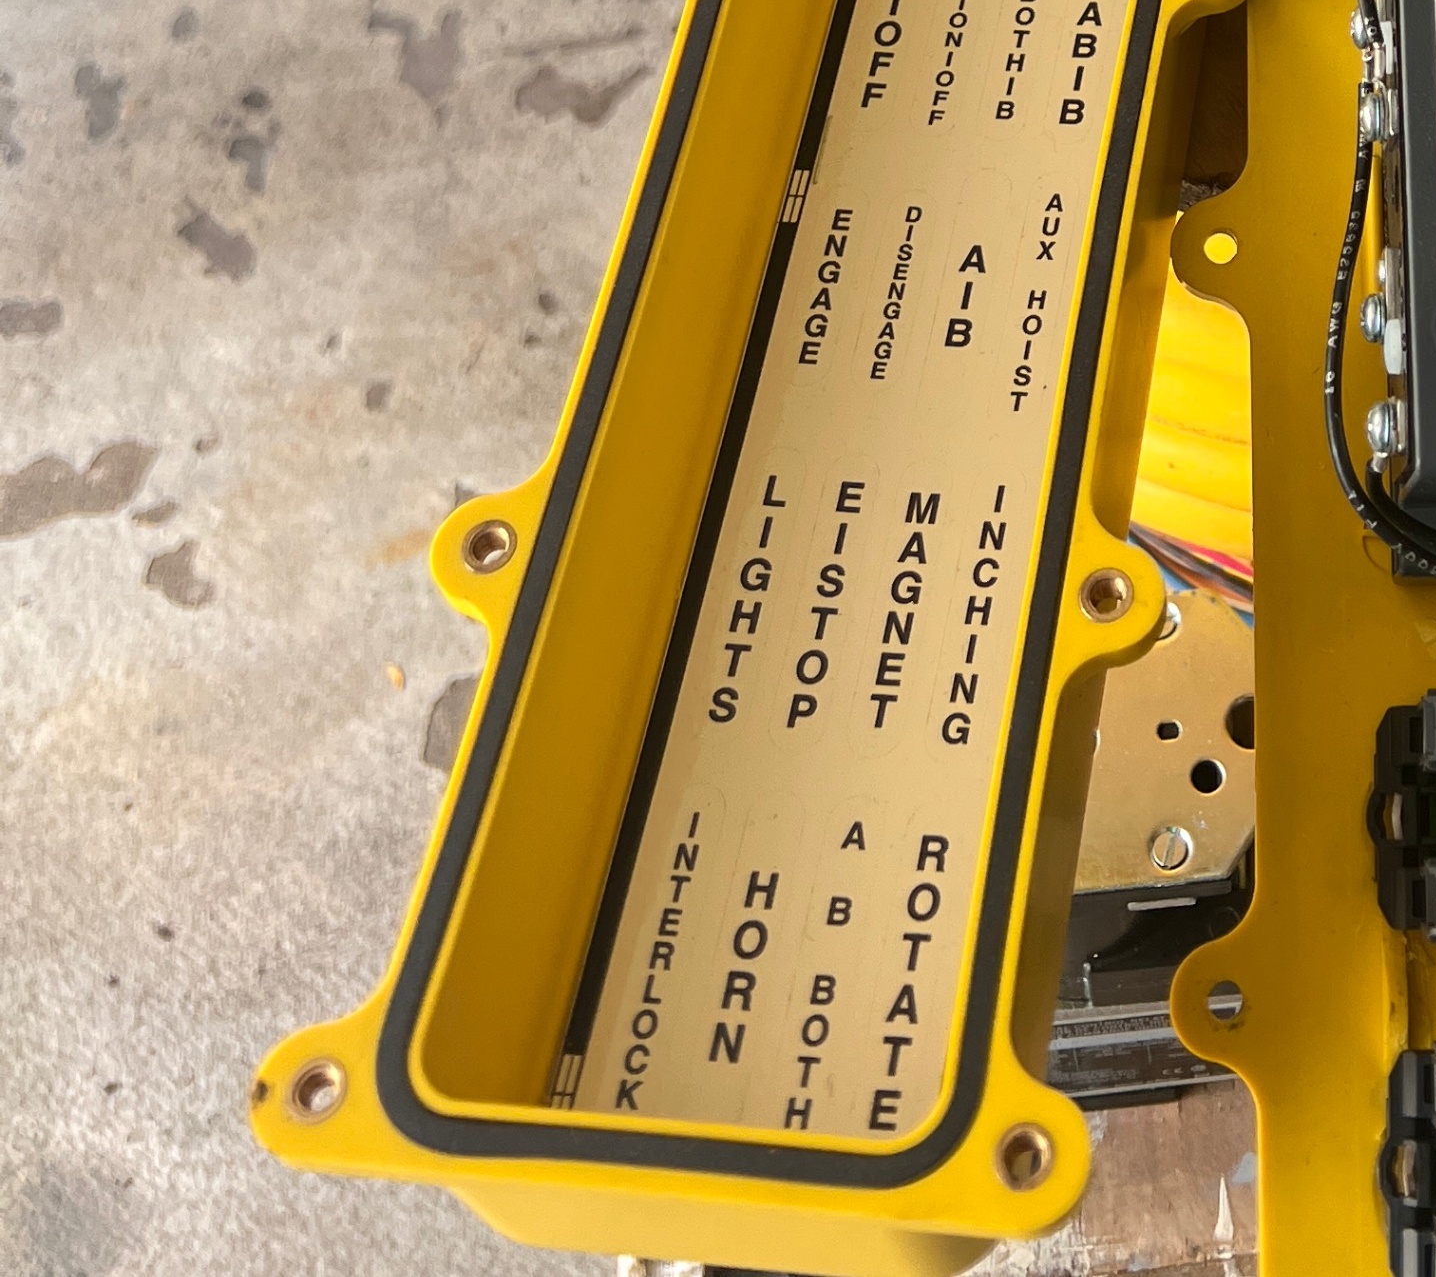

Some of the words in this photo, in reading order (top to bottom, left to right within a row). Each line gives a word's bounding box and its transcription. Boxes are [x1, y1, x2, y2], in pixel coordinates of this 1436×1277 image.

[797, 208, 854, 366] ENGAGE
[869, 205, 923, 380] DISENGAGE
[1035, 193, 1063, 261] AUX
[1010, 289, 1047, 412] HOIST
[708, 474, 787, 724] LIGHTS
[870, 491, 941, 729] MAGNET
[941, 484, 1007, 745] INCHING
[826, 896, 852, 927] B
[840, 821, 866, 851] A
[614, 811, 701, 1111] INTERLOCK
[708, 870, 780, 1064] HORN
[868, 834, 949, 1132] ROTATE
[783, 974, 836, 1130] BOTH
